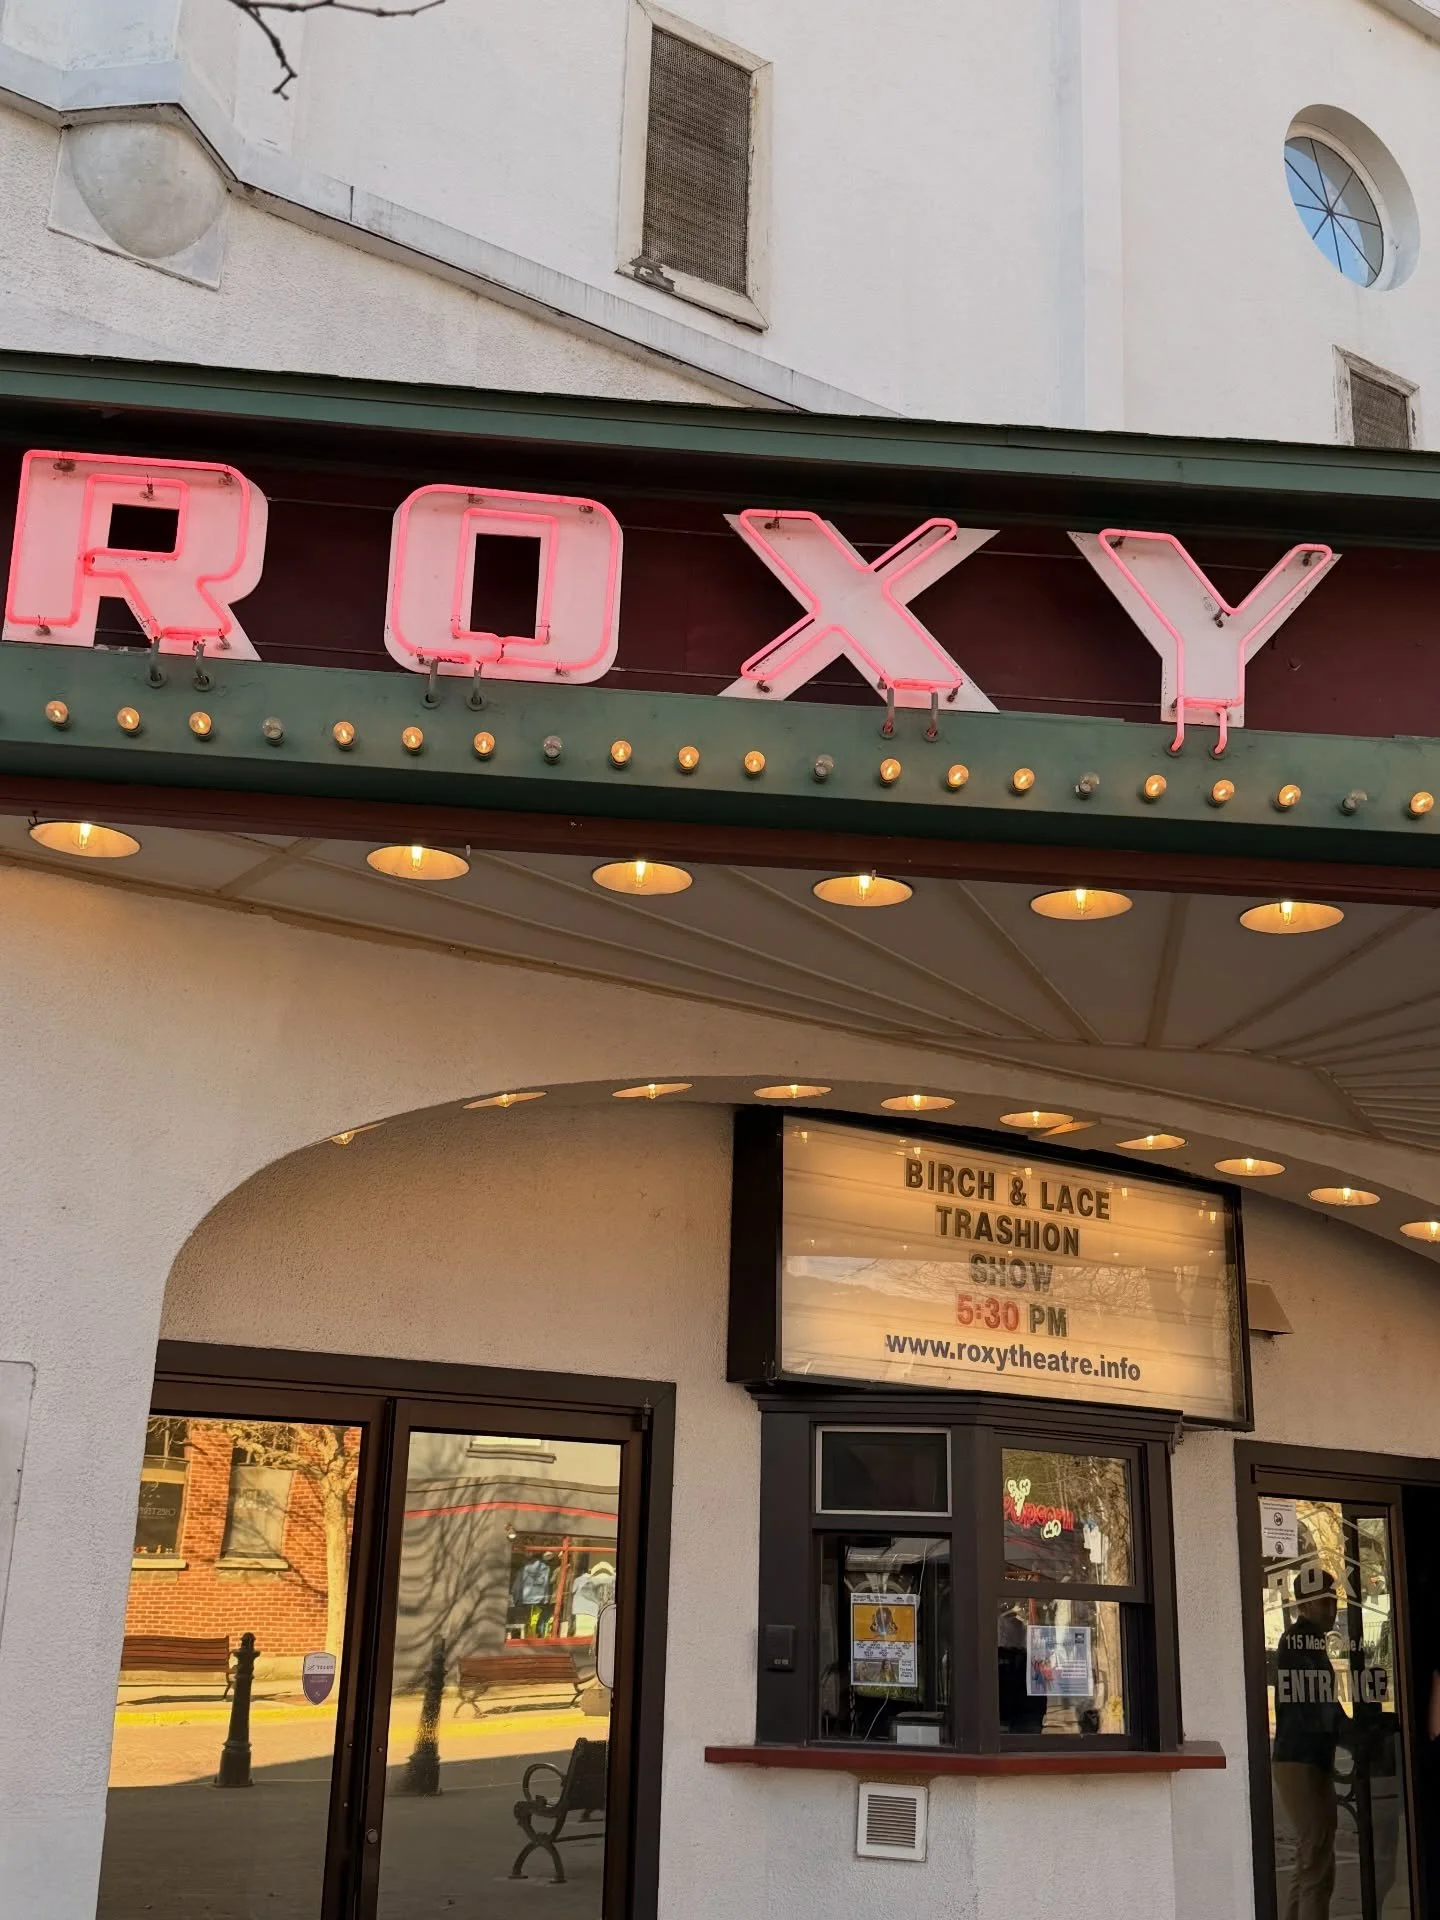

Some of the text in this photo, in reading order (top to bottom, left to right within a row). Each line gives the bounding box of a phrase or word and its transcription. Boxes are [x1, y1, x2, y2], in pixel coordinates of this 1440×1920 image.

[2, 448, 1343, 729] ROXY
[905, 1158, 1110, 1220] BIRCH & LACE
[936, 1205, 1080, 1256] TRASHION
[970, 1253, 1053, 1293] SHOW
[956, 1294, 1068, 1337] 5:30 PM
[886, 1334, 1141, 1381] www.roxytheatre.info
[1285, 1634, 1304, 1650] 115
[1278, 1668, 1388, 1703] ENTRANCE
